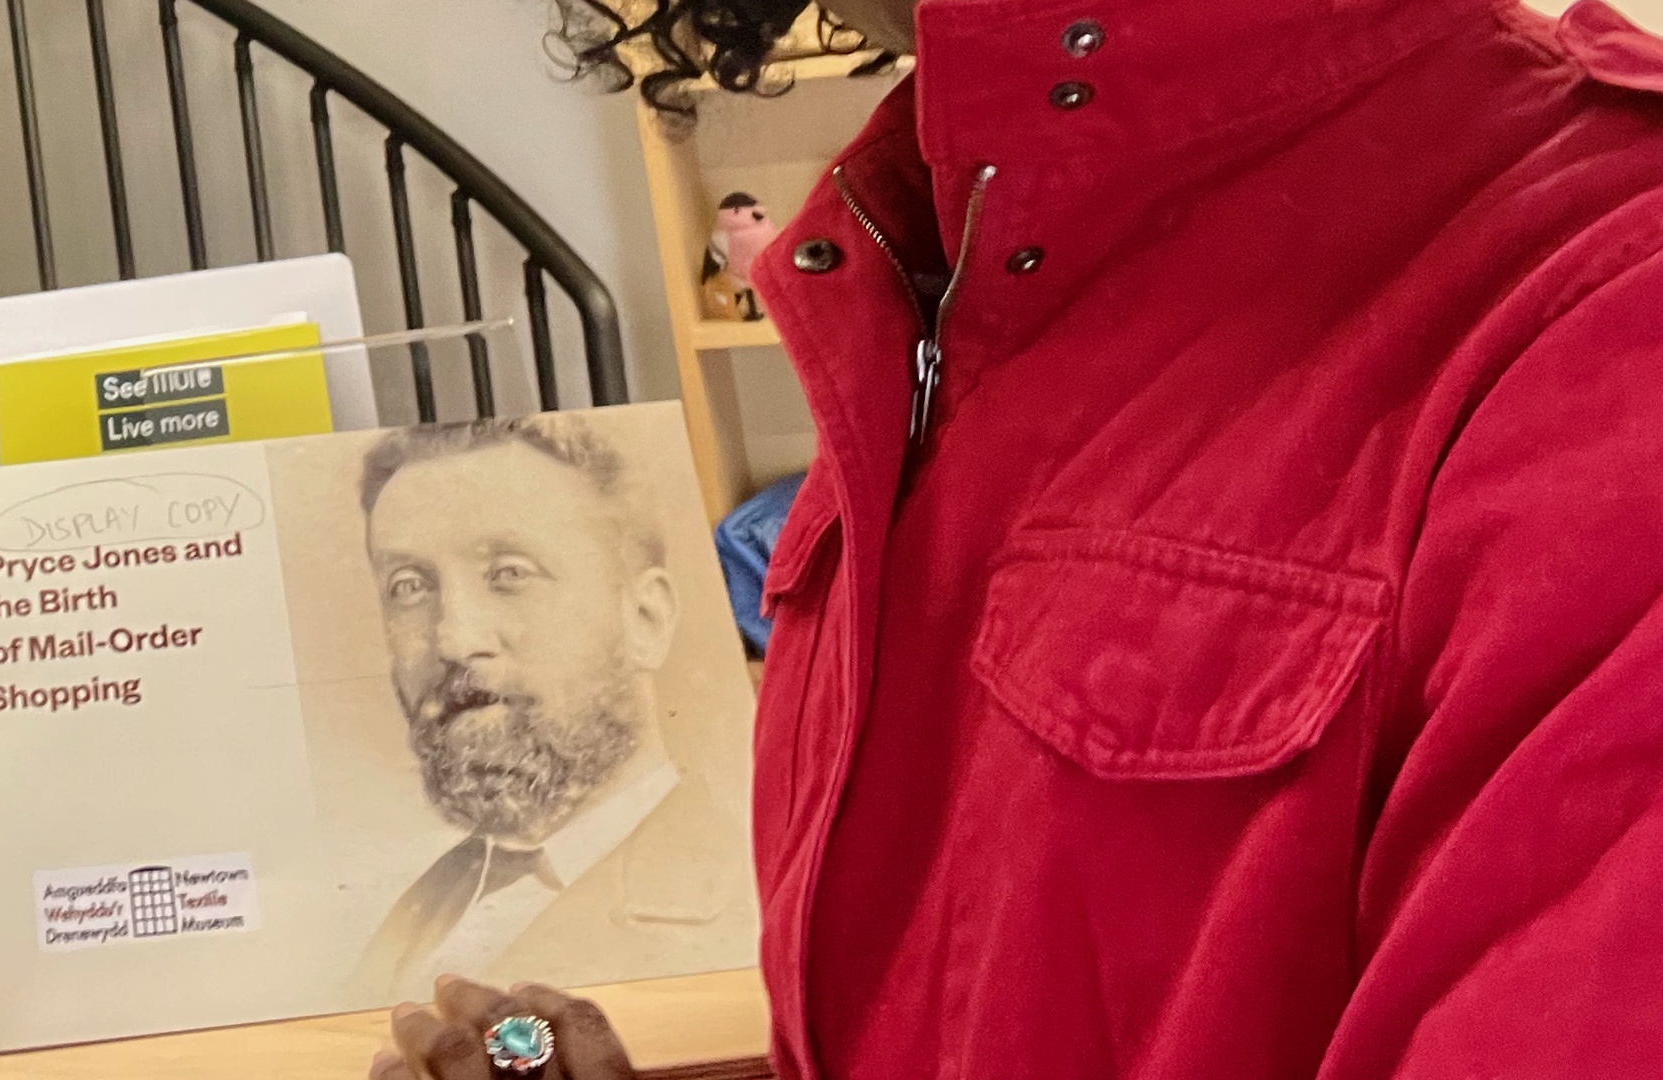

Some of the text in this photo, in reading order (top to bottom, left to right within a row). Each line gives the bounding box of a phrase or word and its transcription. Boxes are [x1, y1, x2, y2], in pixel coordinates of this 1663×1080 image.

[102, 376, 148, 401] See
[107, 410, 219, 441] Live more
[21, 492, 240, 547] DISPLAY COPY
[81, 544, 177, 570] Jones
[184, 531, 243, 560] and
[38, 584, 118, 615] Birth
[28, 623, 203, 662] Mail-Order
[176, 889, 229, 910] Textile
[180, 915, 245, 933] Museum
